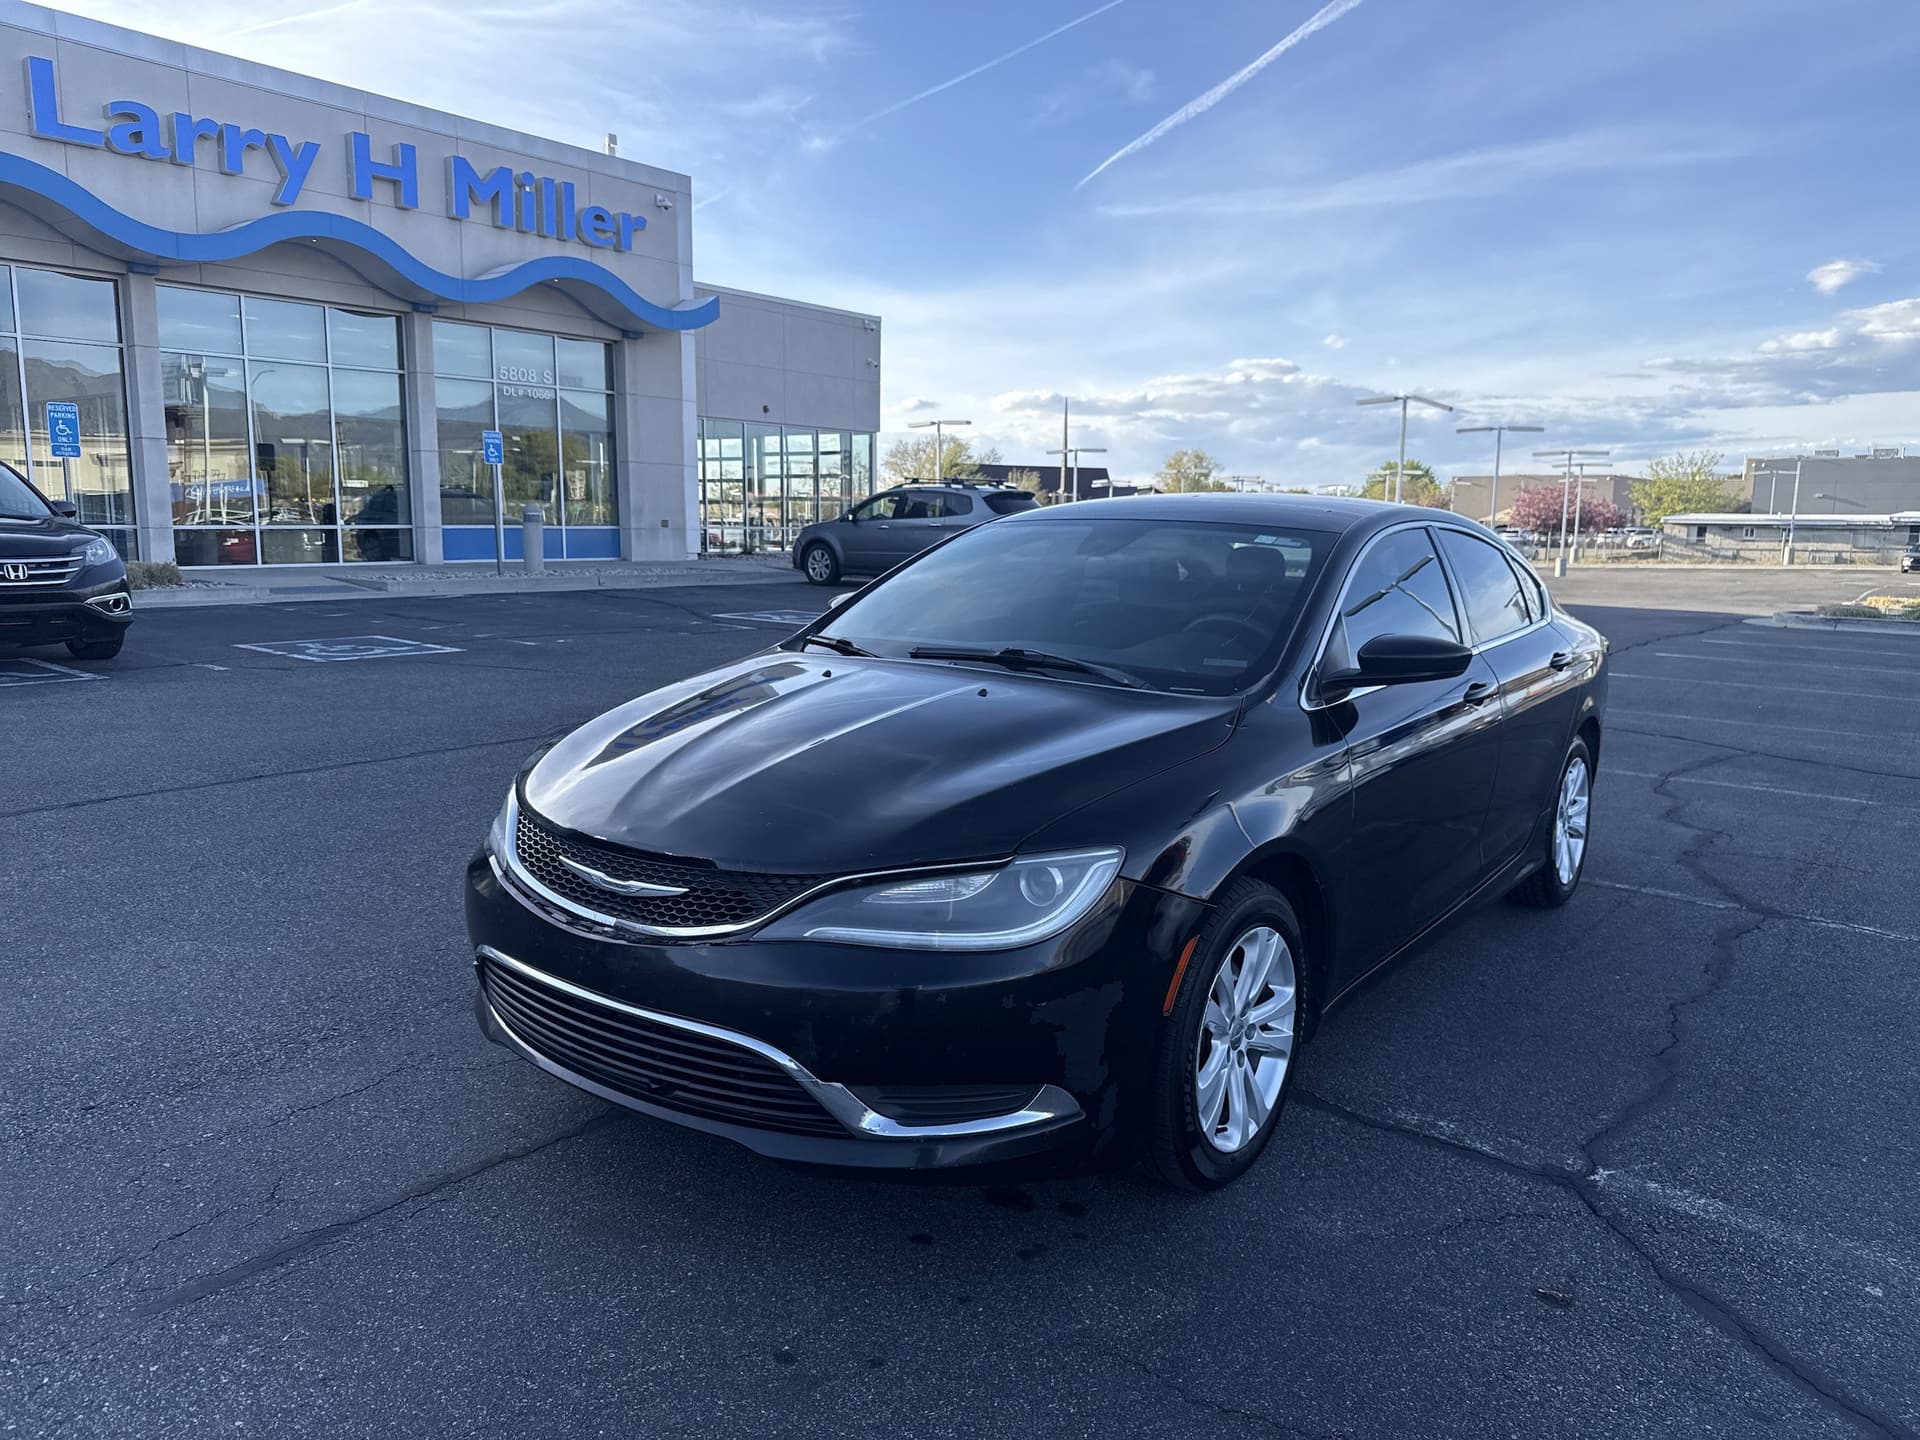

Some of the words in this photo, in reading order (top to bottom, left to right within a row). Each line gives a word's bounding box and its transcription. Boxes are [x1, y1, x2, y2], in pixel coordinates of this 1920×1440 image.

[25, 56, 321, 206] Larry
[346, 132, 419, 210] H
[447, 155, 647, 252] Miller
[500, 366, 537, 383] 5808
[543, 370, 553, 385] S
